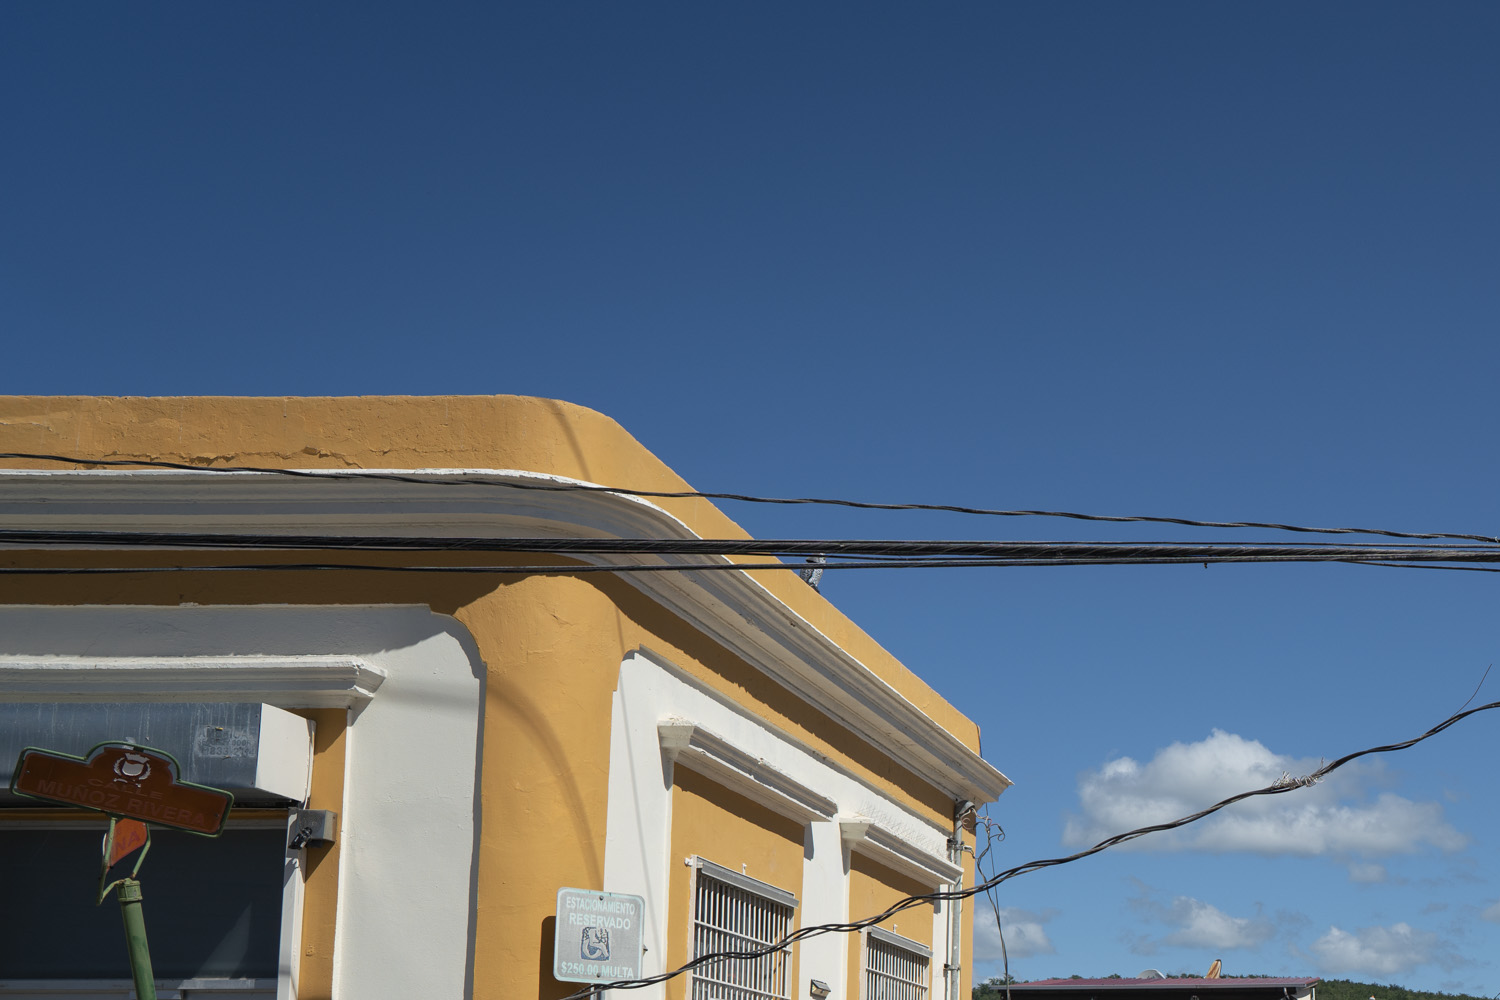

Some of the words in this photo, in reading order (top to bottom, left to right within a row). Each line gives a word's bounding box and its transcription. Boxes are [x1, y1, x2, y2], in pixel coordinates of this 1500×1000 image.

[88, 778, 164, 800] CALLE
[38, 779, 121, 808] MUÑOZ
[126, 797, 205, 827] RIVERA
[566, 897, 635, 915] ESTACIONAMIENTO
[569, 913, 631, 930] RESERVADO
[561, 962, 598, 976] $250.00
[601, 965, 634, 979] MULTA
